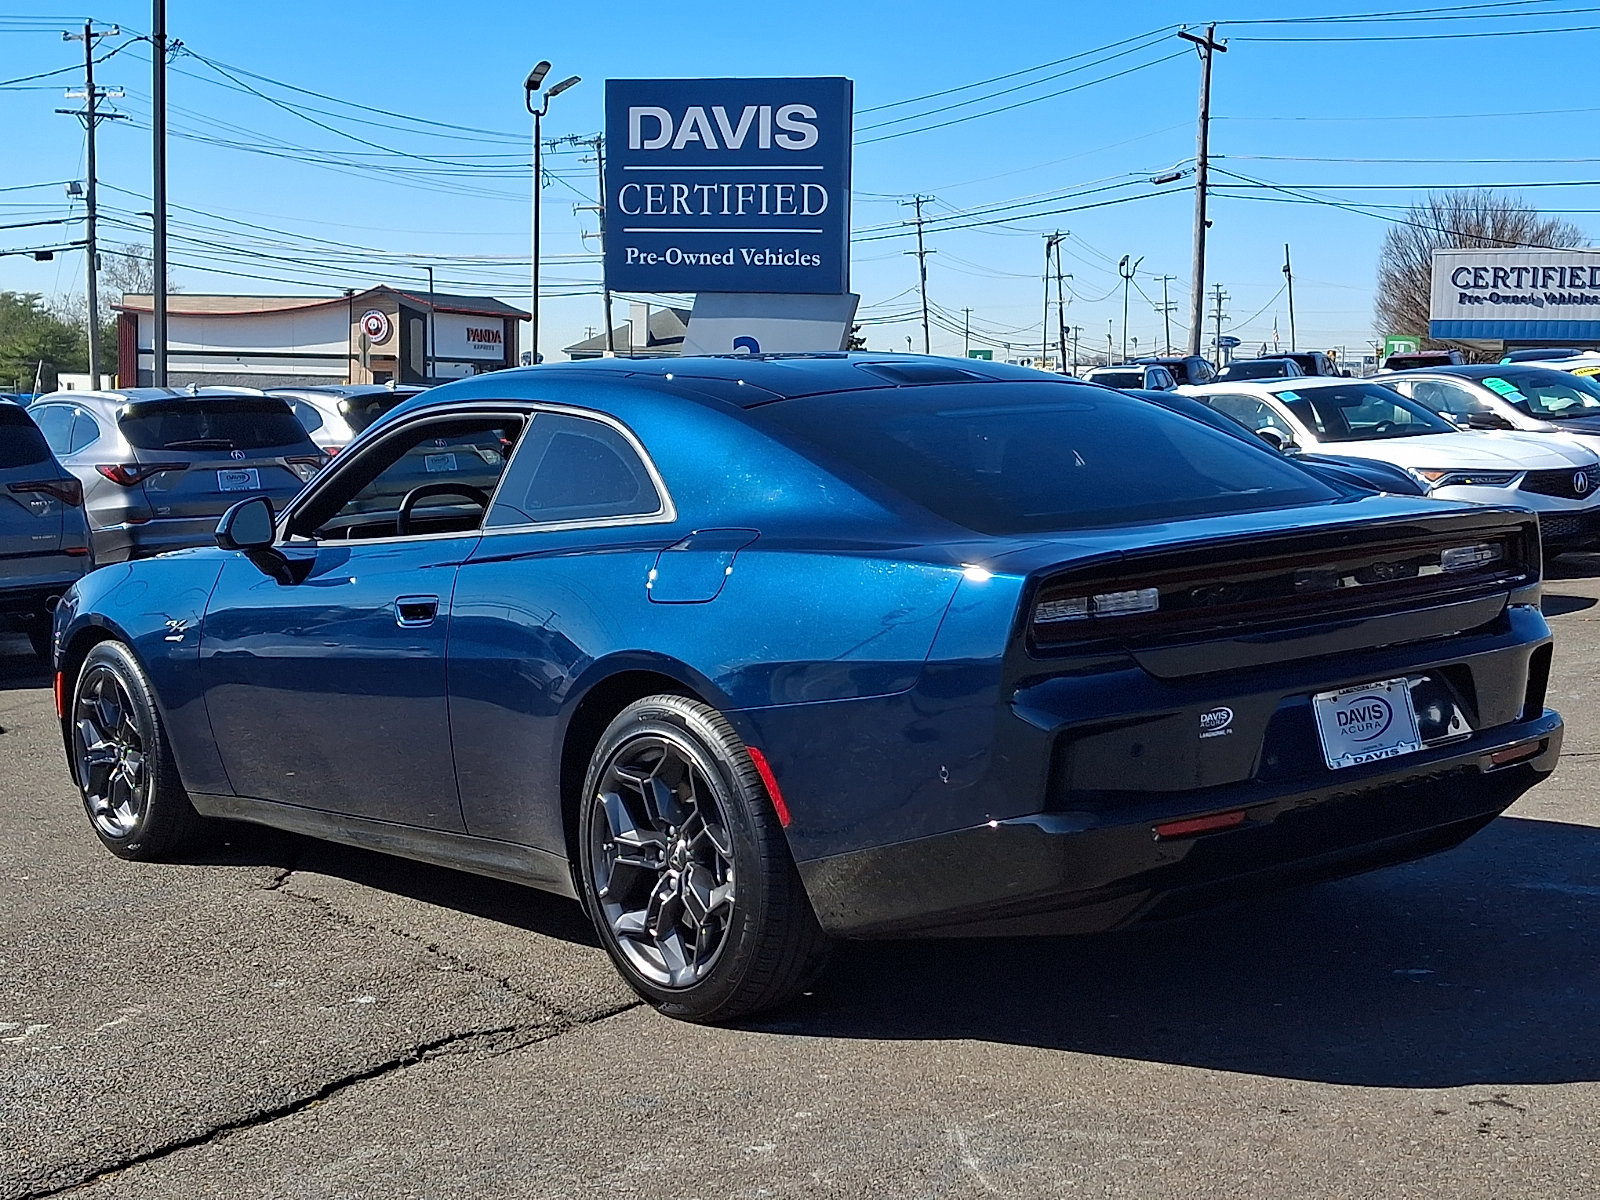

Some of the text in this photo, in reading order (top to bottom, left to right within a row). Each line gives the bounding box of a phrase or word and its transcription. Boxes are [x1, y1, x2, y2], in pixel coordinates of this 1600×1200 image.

[628, 104, 819, 150] DAVIS
[618, 183, 829, 216] CERTIFIED
[625, 247, 821, 267] Pre-Owned Vehicles
[1543, 292, 1599, 306] Vehicles
[466, 327, 502, 343] PANDA
[1200, 711, 1228, 723] DAVIS
[1200, 719, 1225, 728] ACURA
[1336, 704, 1384, 727] DAVIS
[1340, 721, 1382, 736] ACURA
[1353, 748, 1399, 764] DAVIS
